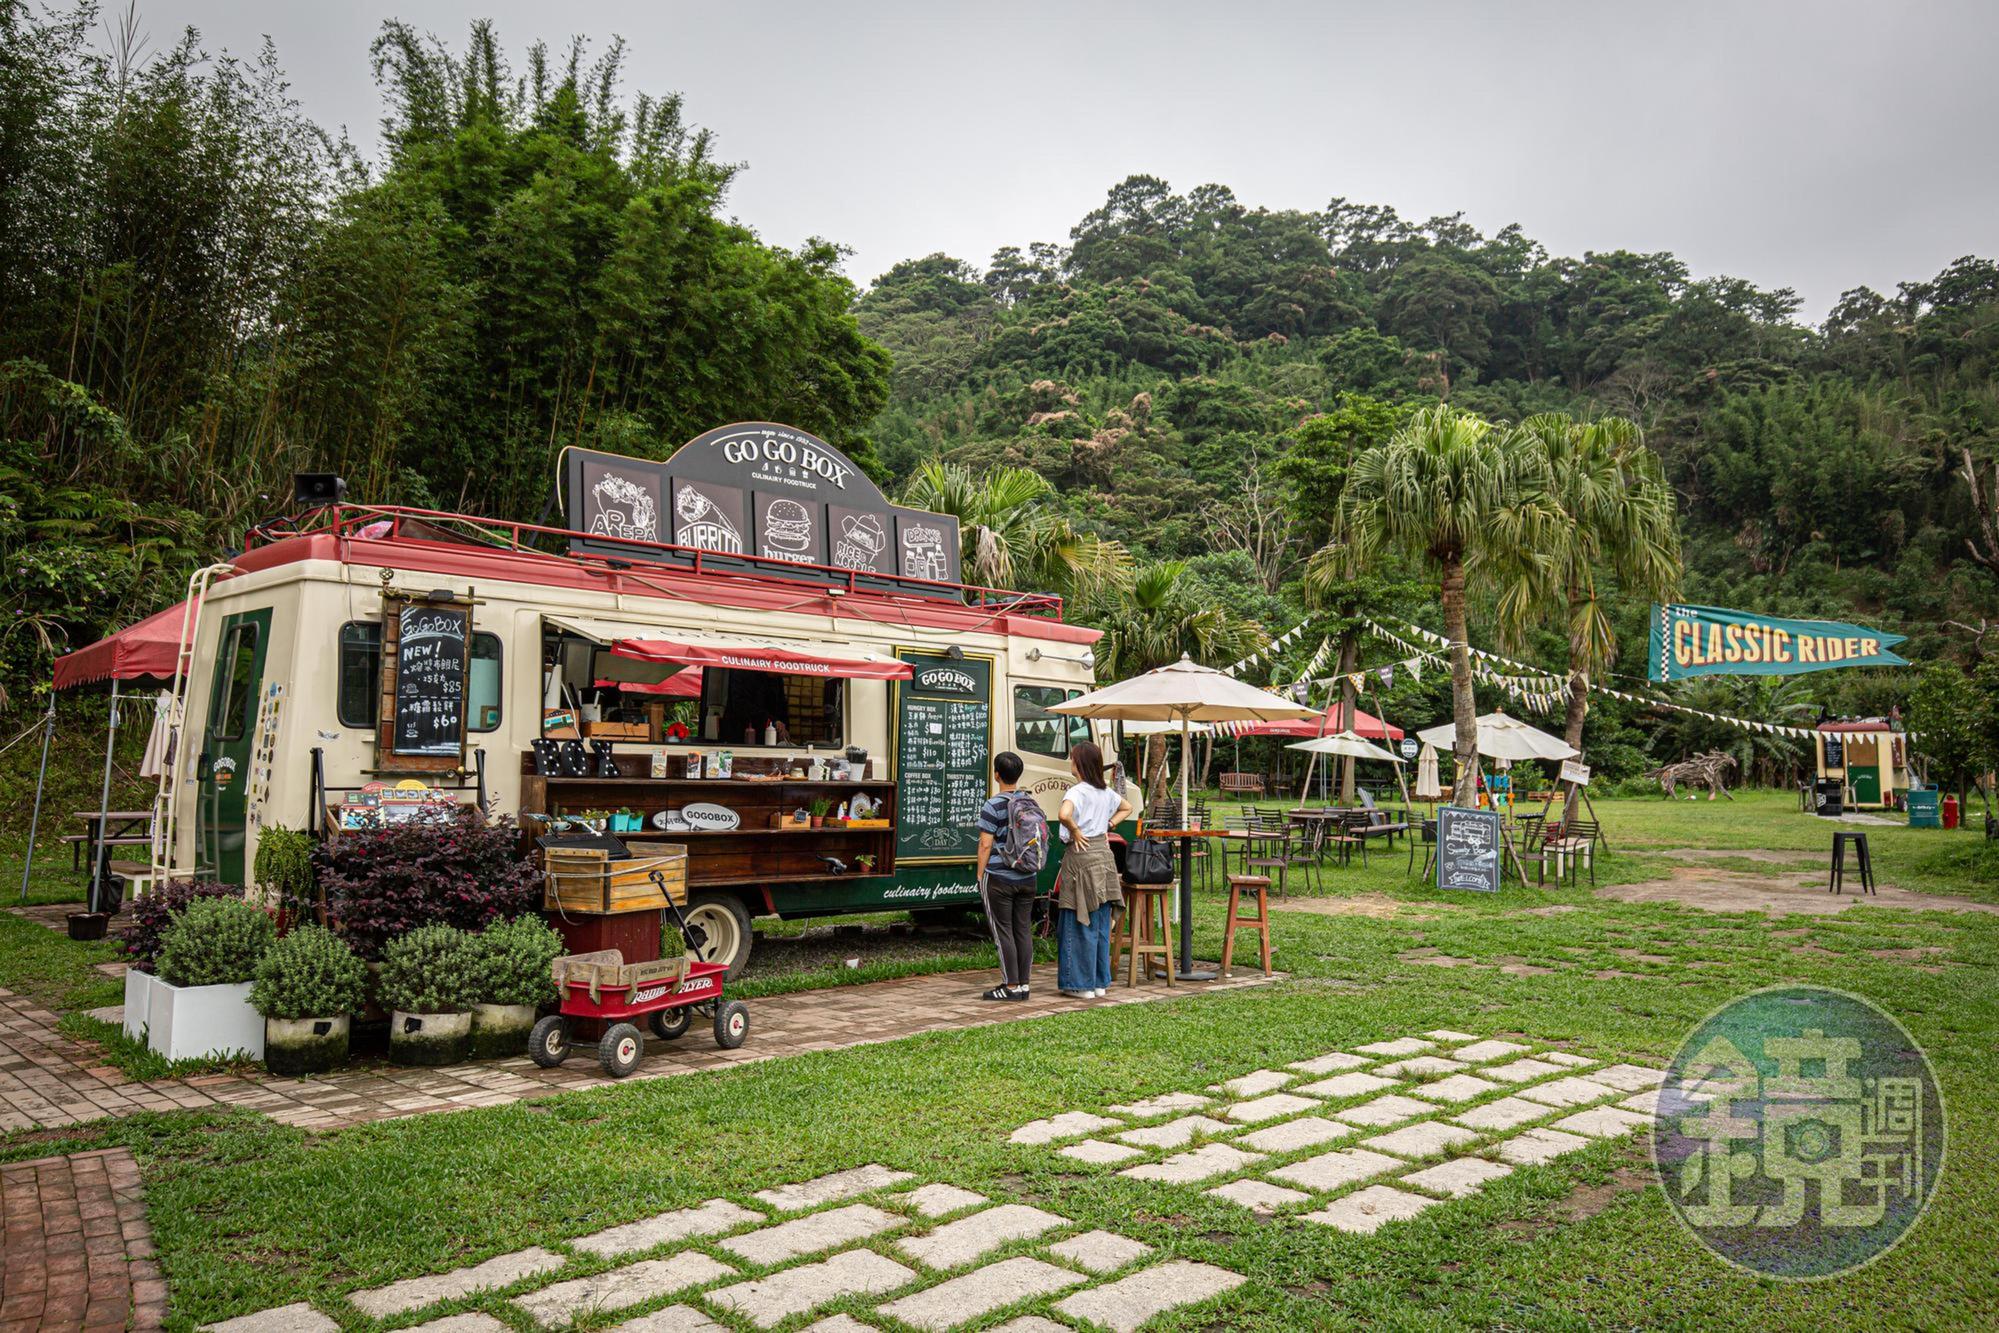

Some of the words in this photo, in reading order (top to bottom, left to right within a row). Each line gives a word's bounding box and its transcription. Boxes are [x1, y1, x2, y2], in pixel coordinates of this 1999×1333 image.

[724, 440, 759, 463] GO
[762, 439, 797, 463] GO
[800, 447, 849, 489] BOX
[752, 472, 782, 483] CULINAIRY
[784, 478, 817, 489] FOODTRUCK
[590, 510, 658, 542] AREPA
[678, 522, 742, 555] BURRITO
[763, 545, 816, 565] burger
[837, 540, 861, 561] RICE
[1675, 607, 1698, 618] the
[1674, 620, 1793, 668] CLASSIC
[1798, 634, 1881, 663] RIDER
[721, 656, 771, 668] CULINAIRY
[774, 661, 831, 673] FOODTRUCK
[443, 681, 461, 693] $85
[1034, 784, 1046, 794] GO
[1047, 780, 1059, 790] GO
[687, 811, 734, 822] GOGOBOX
[883, 884, 931, 899] culinairy
[932, 883, 979, 899] foodtruck
[631, 986, 671, 1004] RADIO
